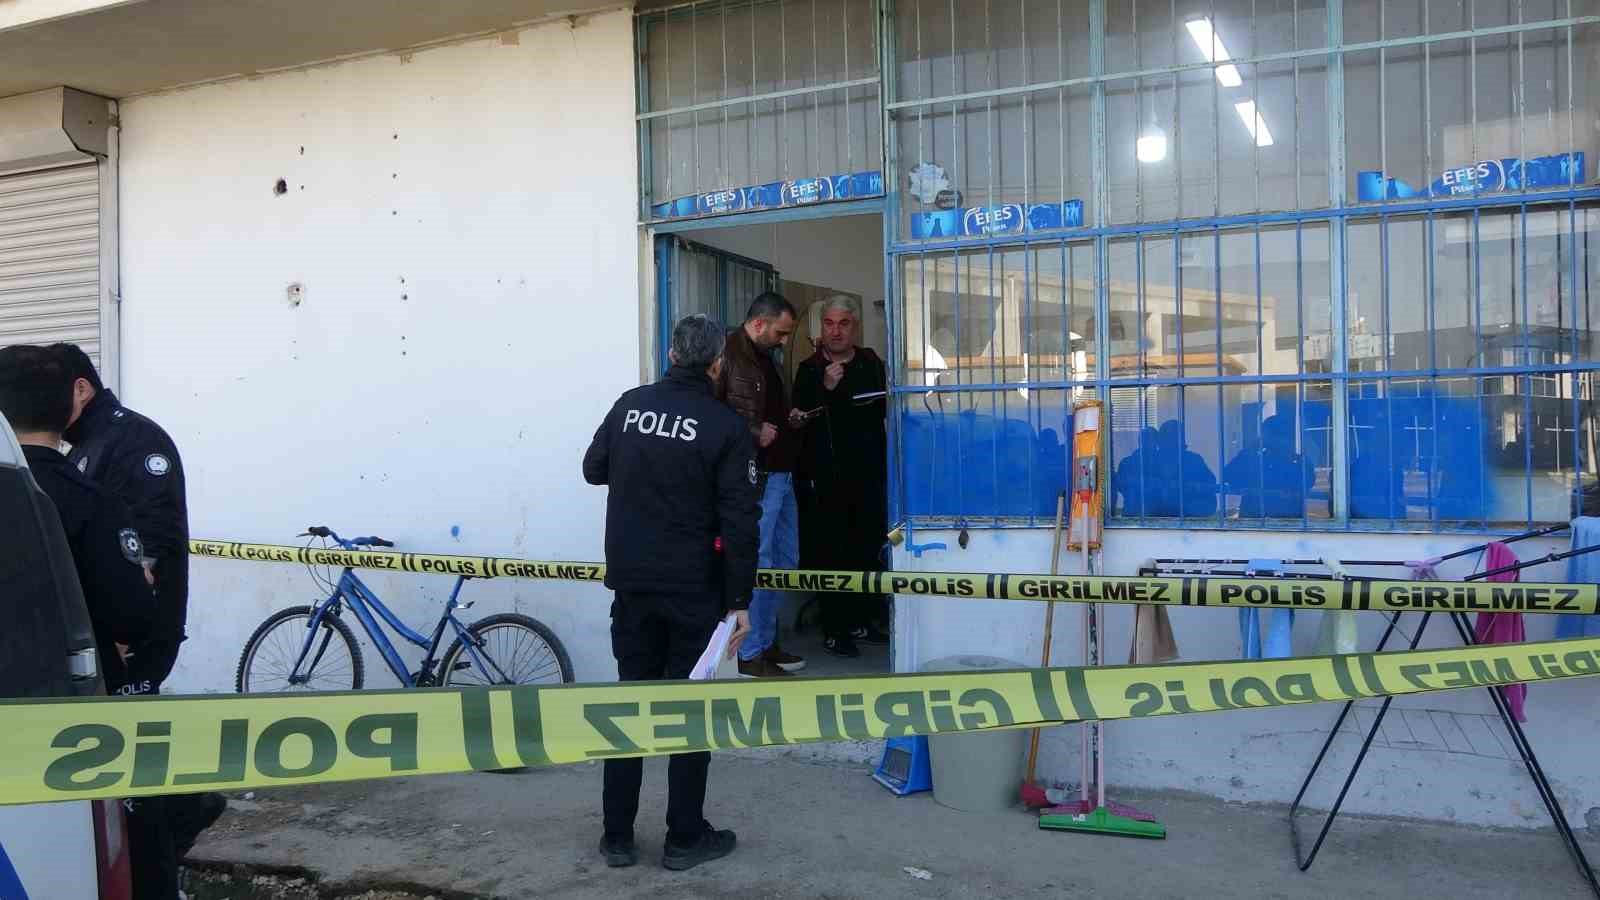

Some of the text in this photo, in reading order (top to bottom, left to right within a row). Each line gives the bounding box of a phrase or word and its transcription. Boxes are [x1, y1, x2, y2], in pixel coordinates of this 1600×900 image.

[1442, 163, 1490, 185] EFES
[705, 190, 736, 207] EFES
[790, 180, 824, 198] EFES
[975, 206, 1012, 226] EFES
